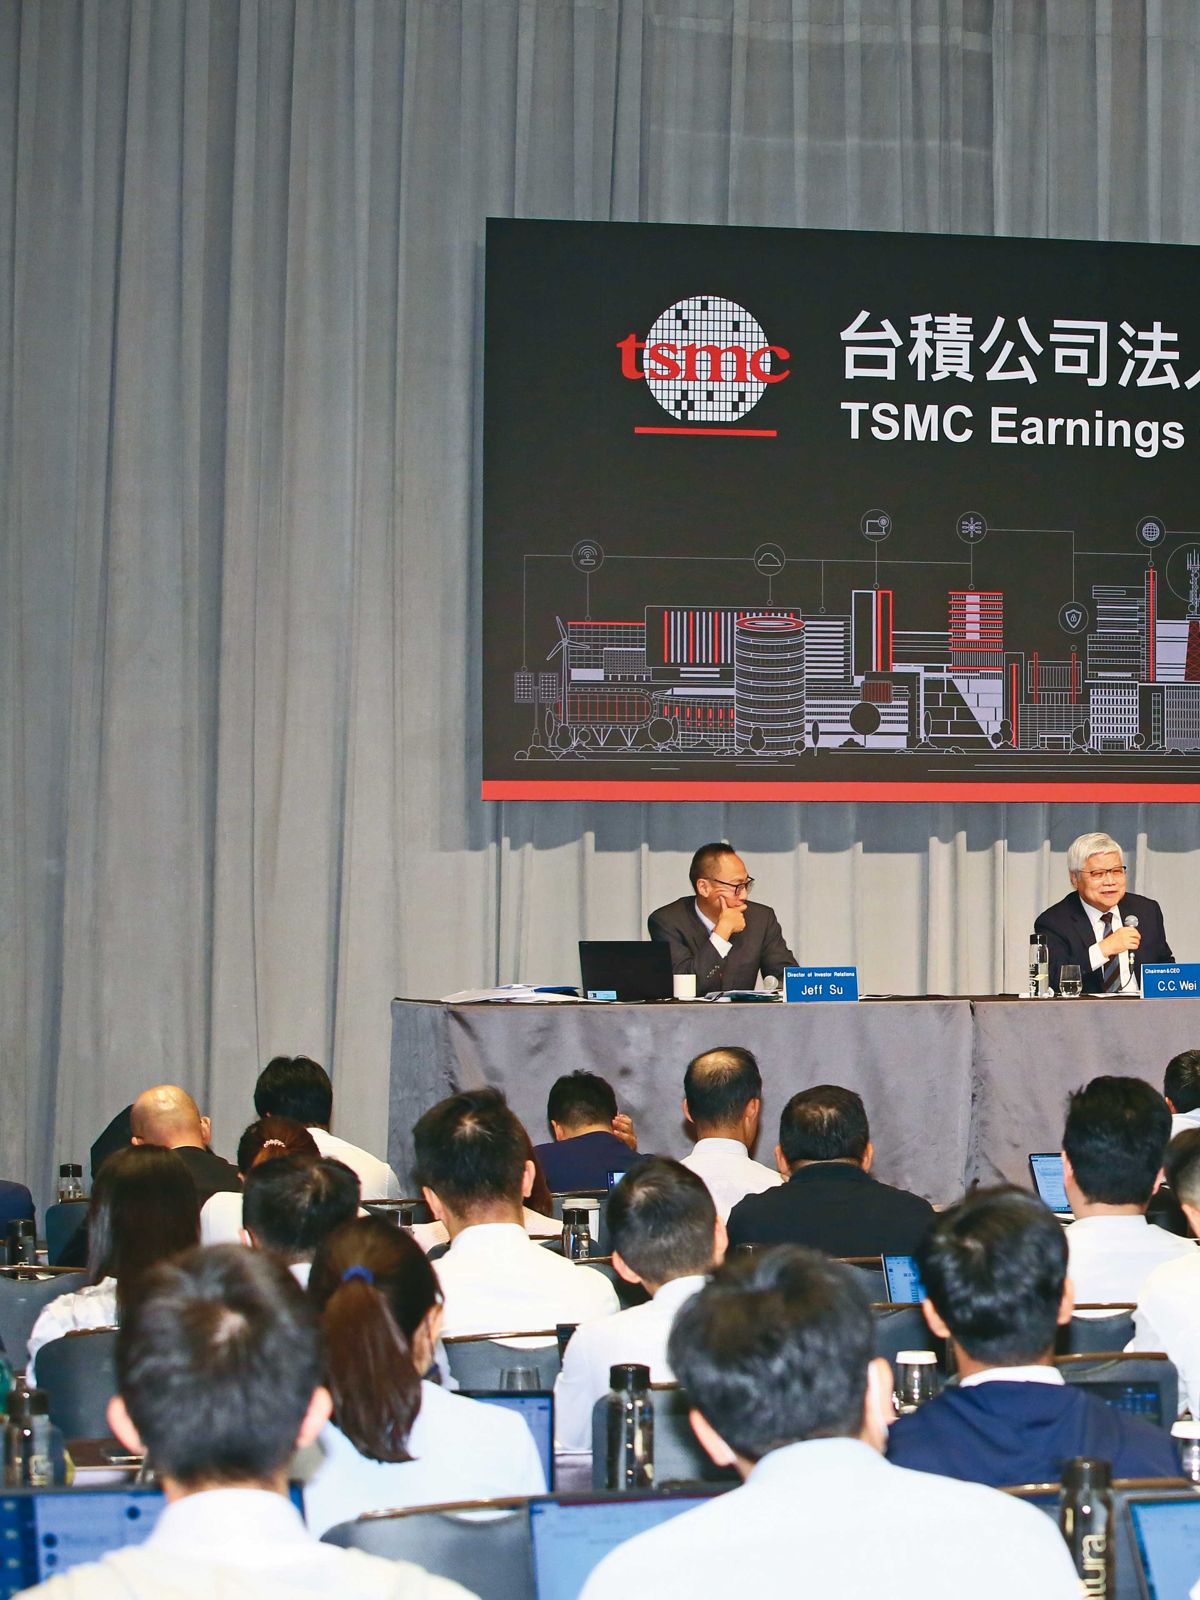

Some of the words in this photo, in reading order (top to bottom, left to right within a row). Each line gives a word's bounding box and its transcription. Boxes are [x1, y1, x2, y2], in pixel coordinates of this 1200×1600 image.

[616, 333, 791, 384] tsmc
[841, 402, 974, 442] TSMC
[991, 407, 1185, 458] Earnings
[801, 984, 823, 996] Jeff
[829, 984, 843, 995] Su
[1157, 980, 1178, 991] C.C.
[1179, 980, 1197, 990] Wei
